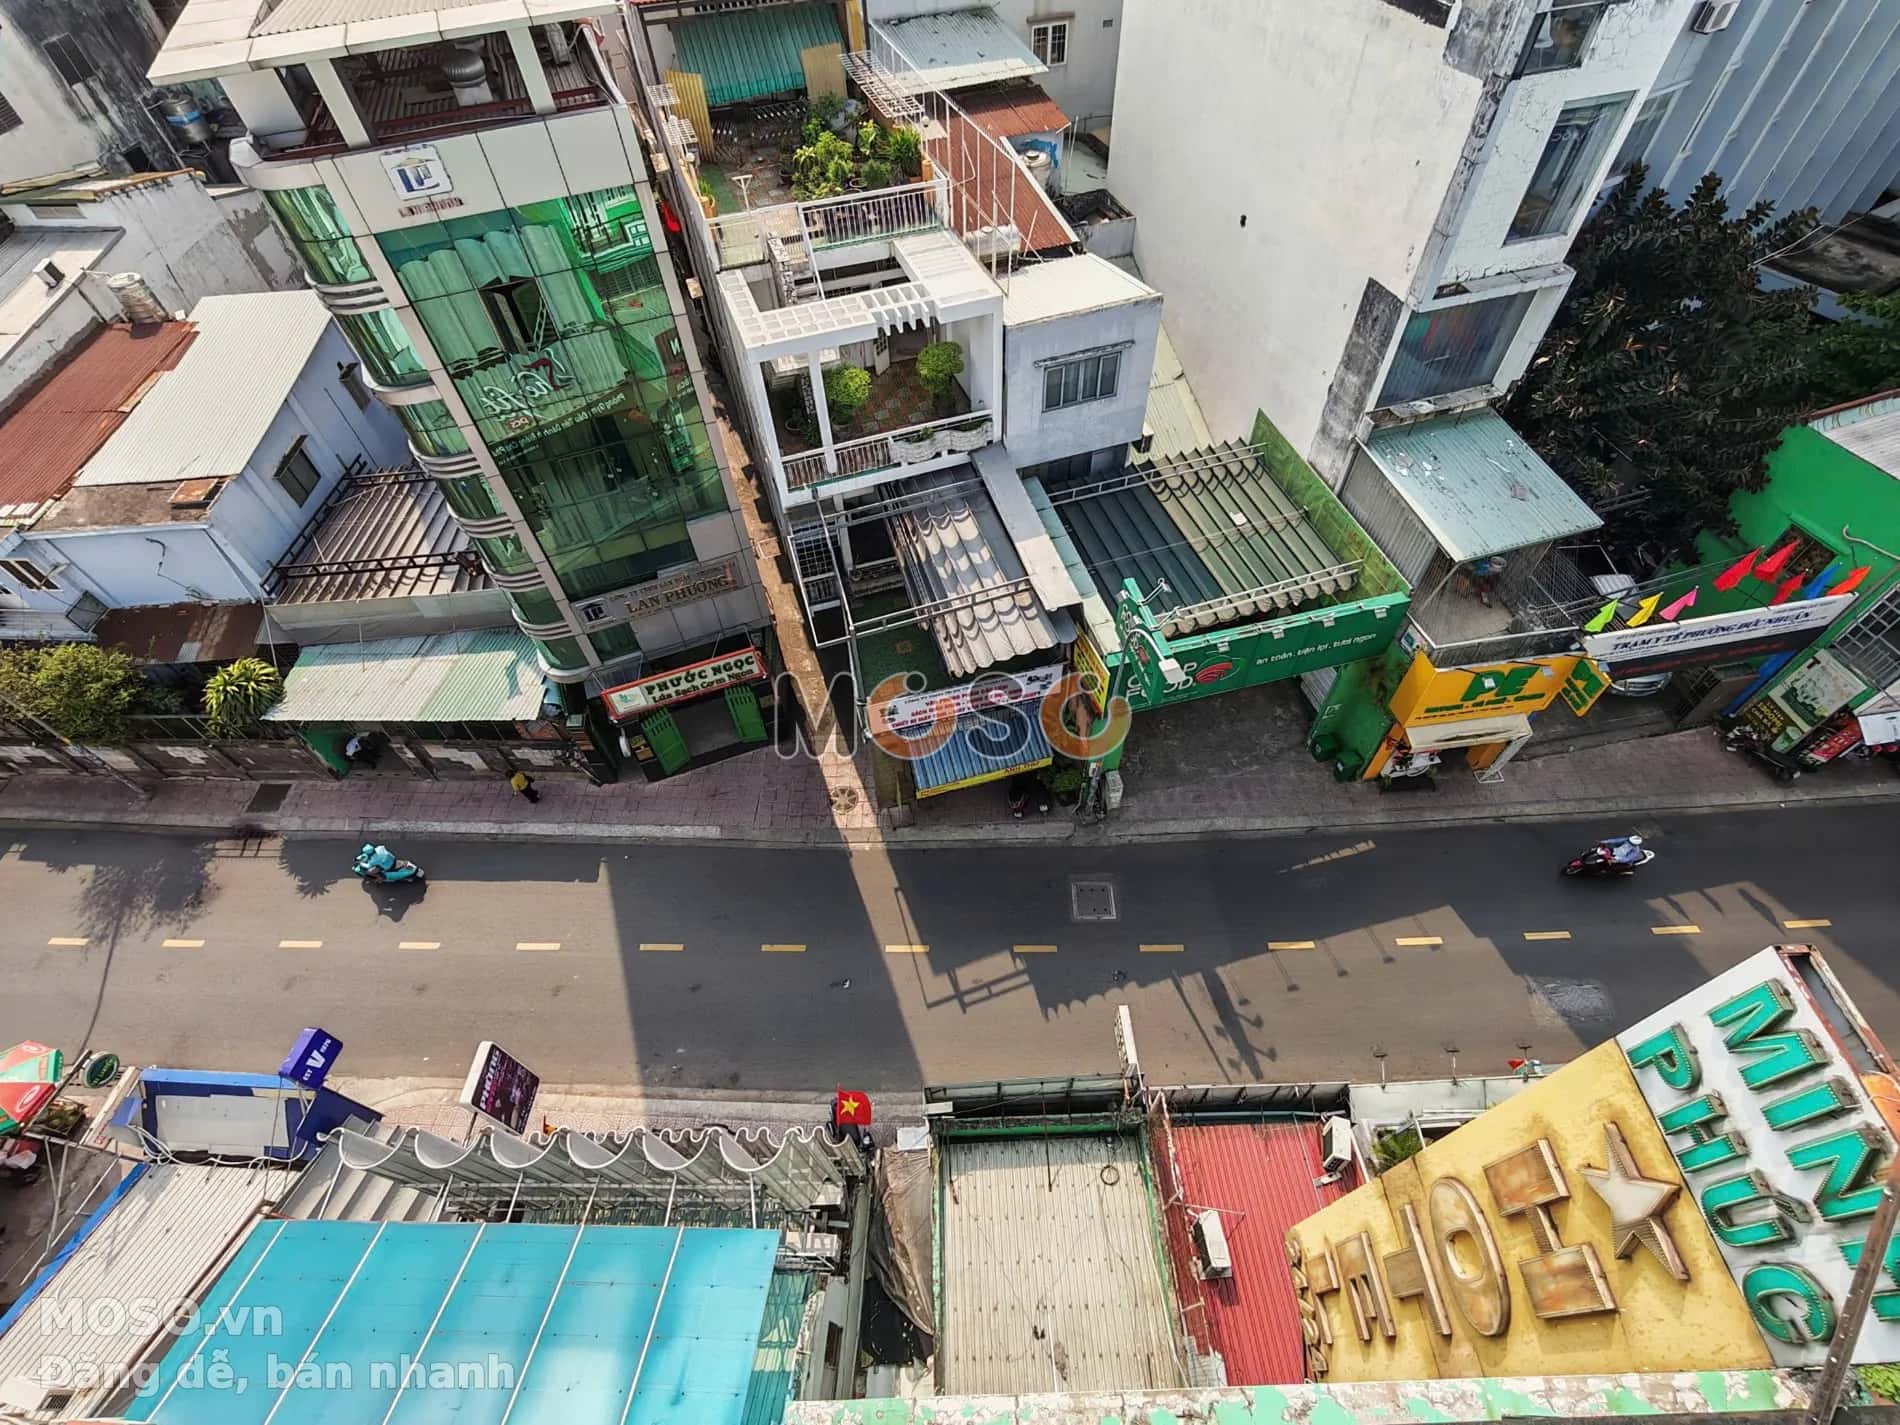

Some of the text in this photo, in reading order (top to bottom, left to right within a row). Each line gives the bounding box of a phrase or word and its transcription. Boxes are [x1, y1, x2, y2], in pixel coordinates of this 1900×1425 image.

[626, 596, 663, 614] LAN
[644, 655, 756, 695] PHƯỚC NGỌC
[306, 1050, 326, 1069] V
[1626, 1023, 1837, 1344] PHÚC
